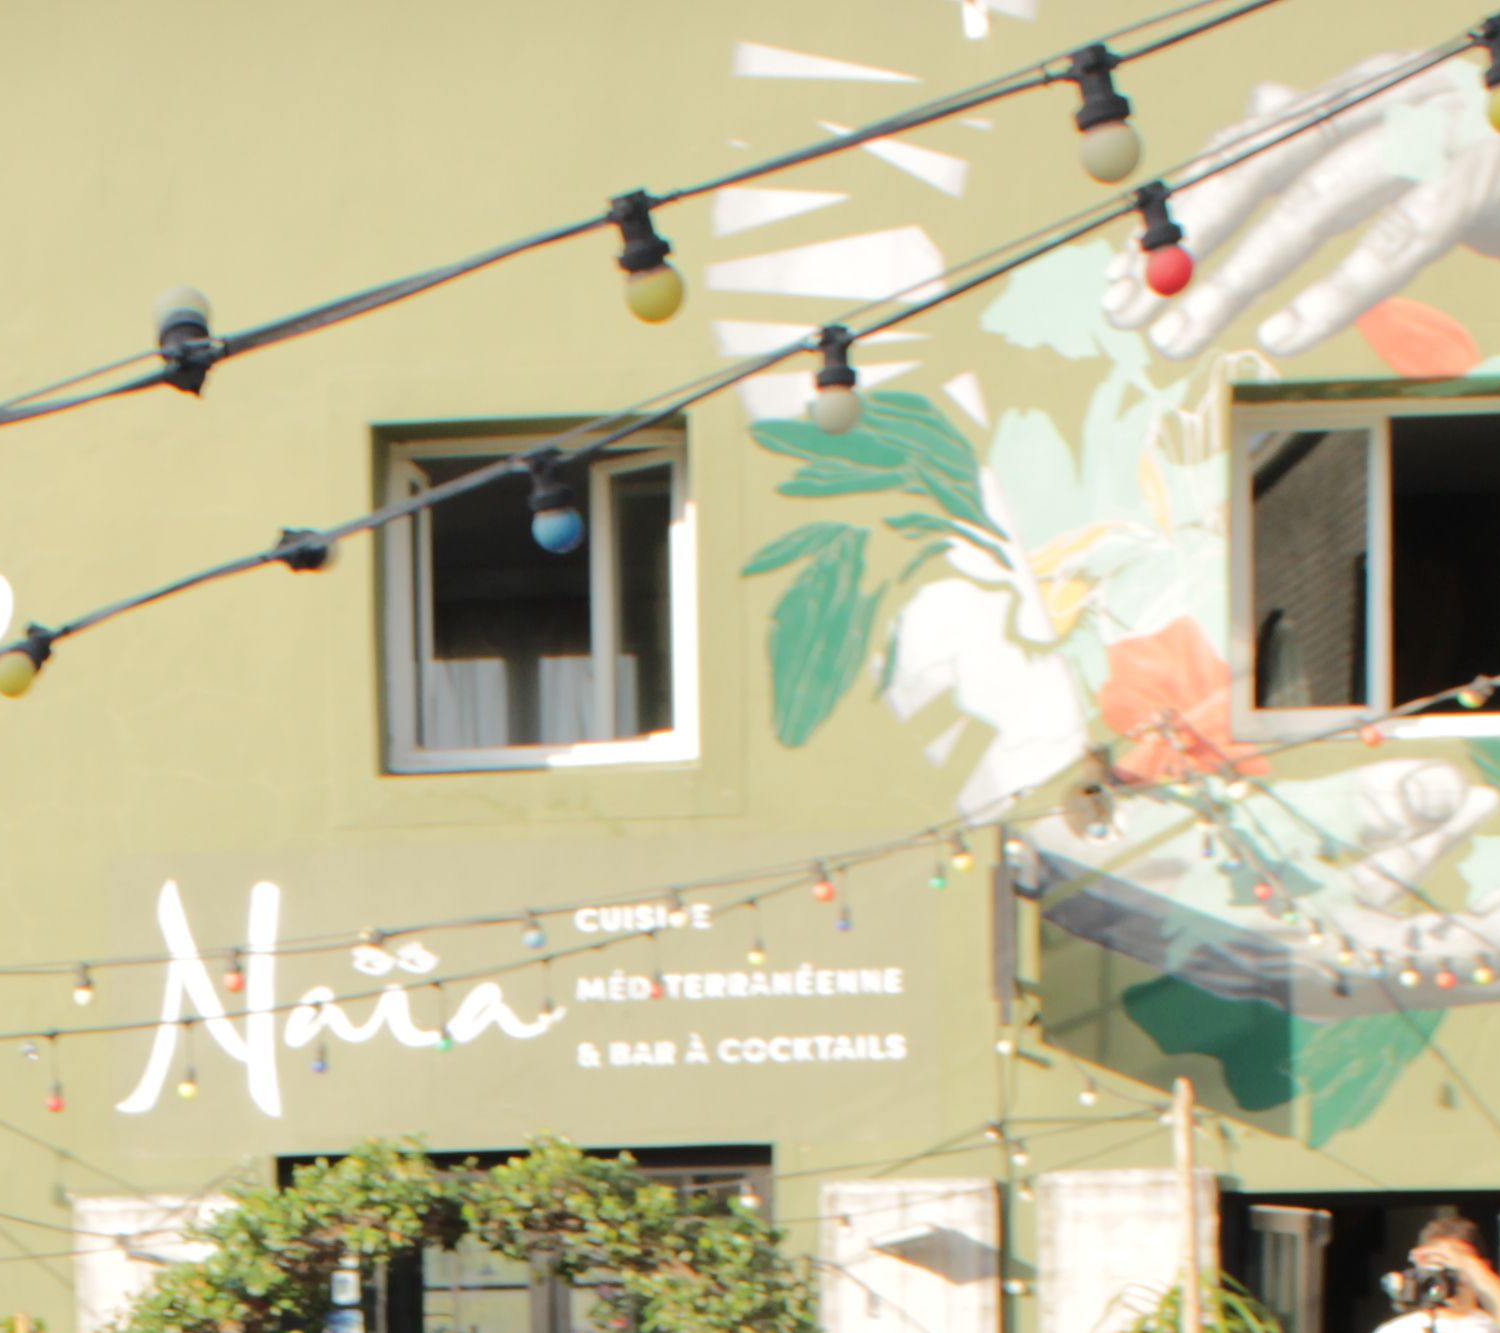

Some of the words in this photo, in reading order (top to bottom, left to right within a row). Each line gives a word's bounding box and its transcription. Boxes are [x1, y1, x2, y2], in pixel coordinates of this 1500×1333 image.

[574, 902, 712, 933] CUISIE
[576, 964, 904, 1001] MÉDTERRANÉENNE
[576, 1041, 602, 1068] &
[609, 1040, 677, 1067] BAR
[685, 1032, 709, 1063] À
[717, 1032, 908, 1063] COCKTAILS
